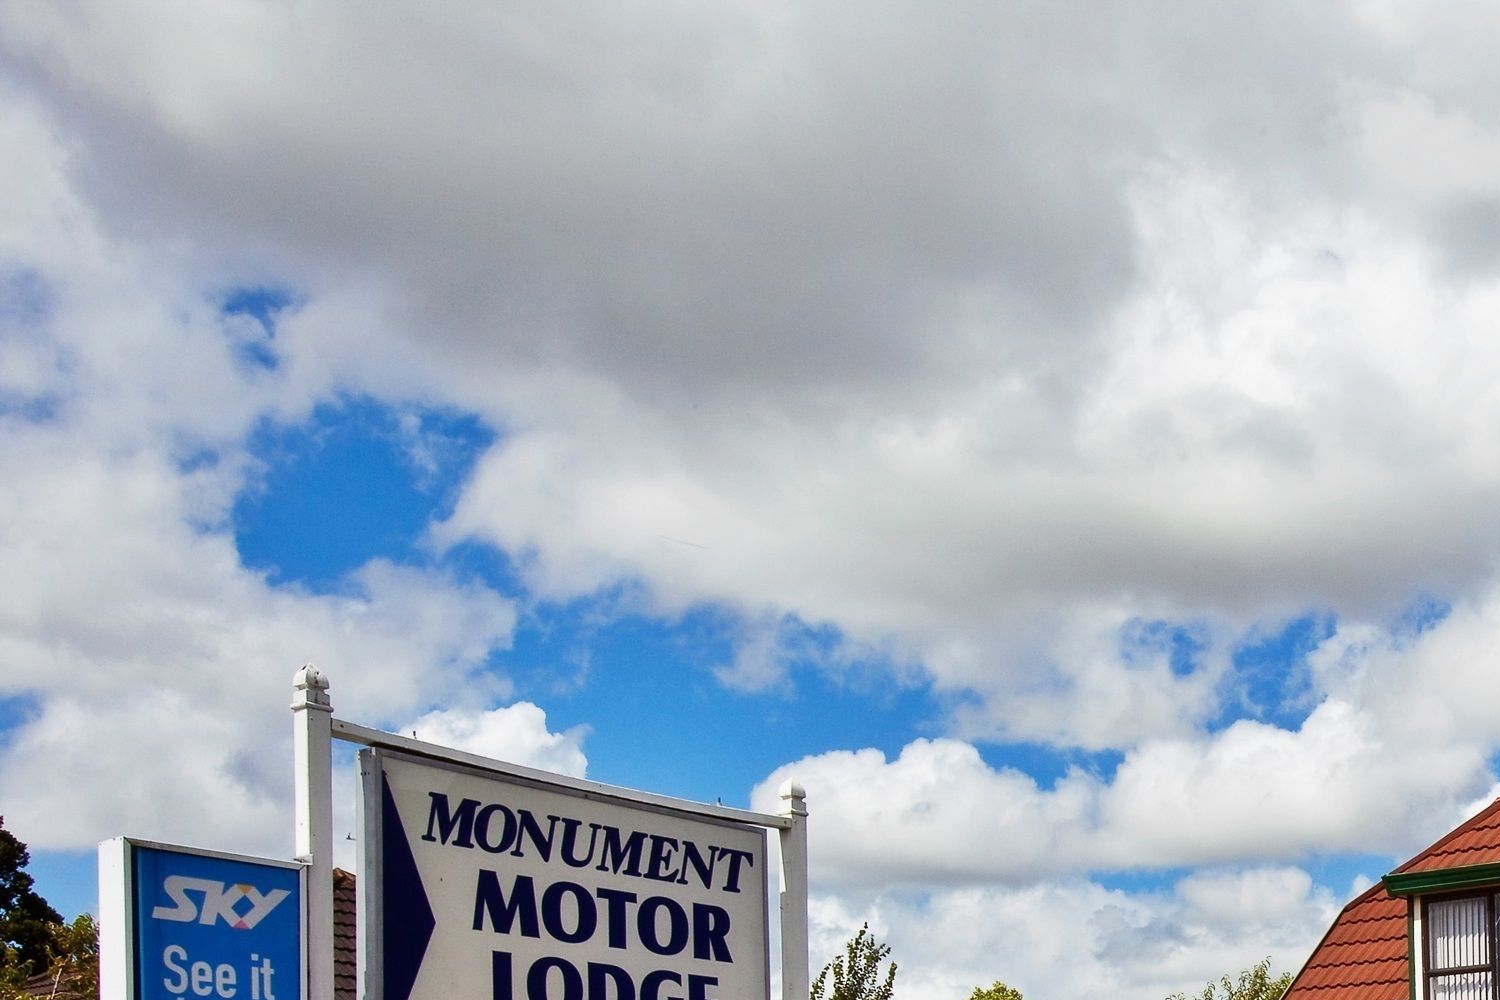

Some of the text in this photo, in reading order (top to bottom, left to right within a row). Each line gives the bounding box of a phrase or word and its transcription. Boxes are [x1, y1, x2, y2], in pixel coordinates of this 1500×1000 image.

[421, 791, 754, 894] MONUMENT
[152, 874, 292, 930] SKY
[472, 868, 734, 964] MOTOR
[163, 944, 237, 999] See
